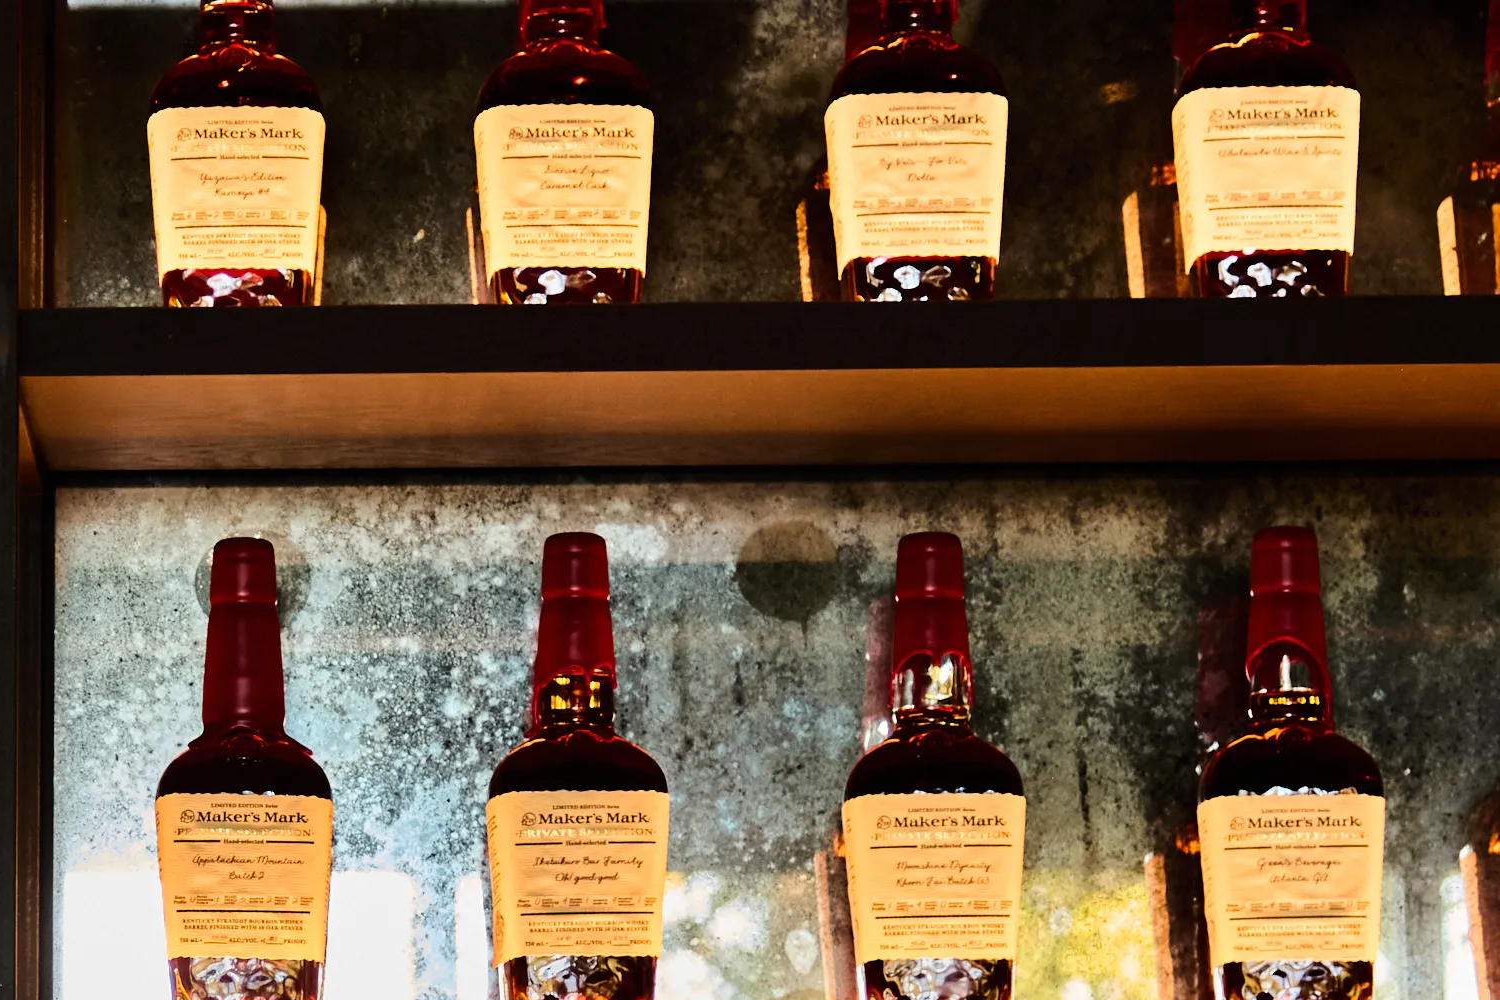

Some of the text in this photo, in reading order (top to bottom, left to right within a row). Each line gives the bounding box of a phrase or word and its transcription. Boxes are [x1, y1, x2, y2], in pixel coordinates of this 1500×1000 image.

[1227, 108, 1338, 120] Maker's Mark
[876, 114, 986, 126] Maker's Mark
[194, 128, 303, 139] Maker's Mark
[526, 127, 636, 138] Maker's Mark
[196, 812, 308, 823] Maker's Mark
[538, 813, 649, 824] Maker's Mark
[894, 816, 1005, 827] Maker's Mark
[1248, 816, 1361, 828] Maker's Mark
[192, 854, 304, 866] Appalachian Mountain
[604, 856, 643, 868] Family
